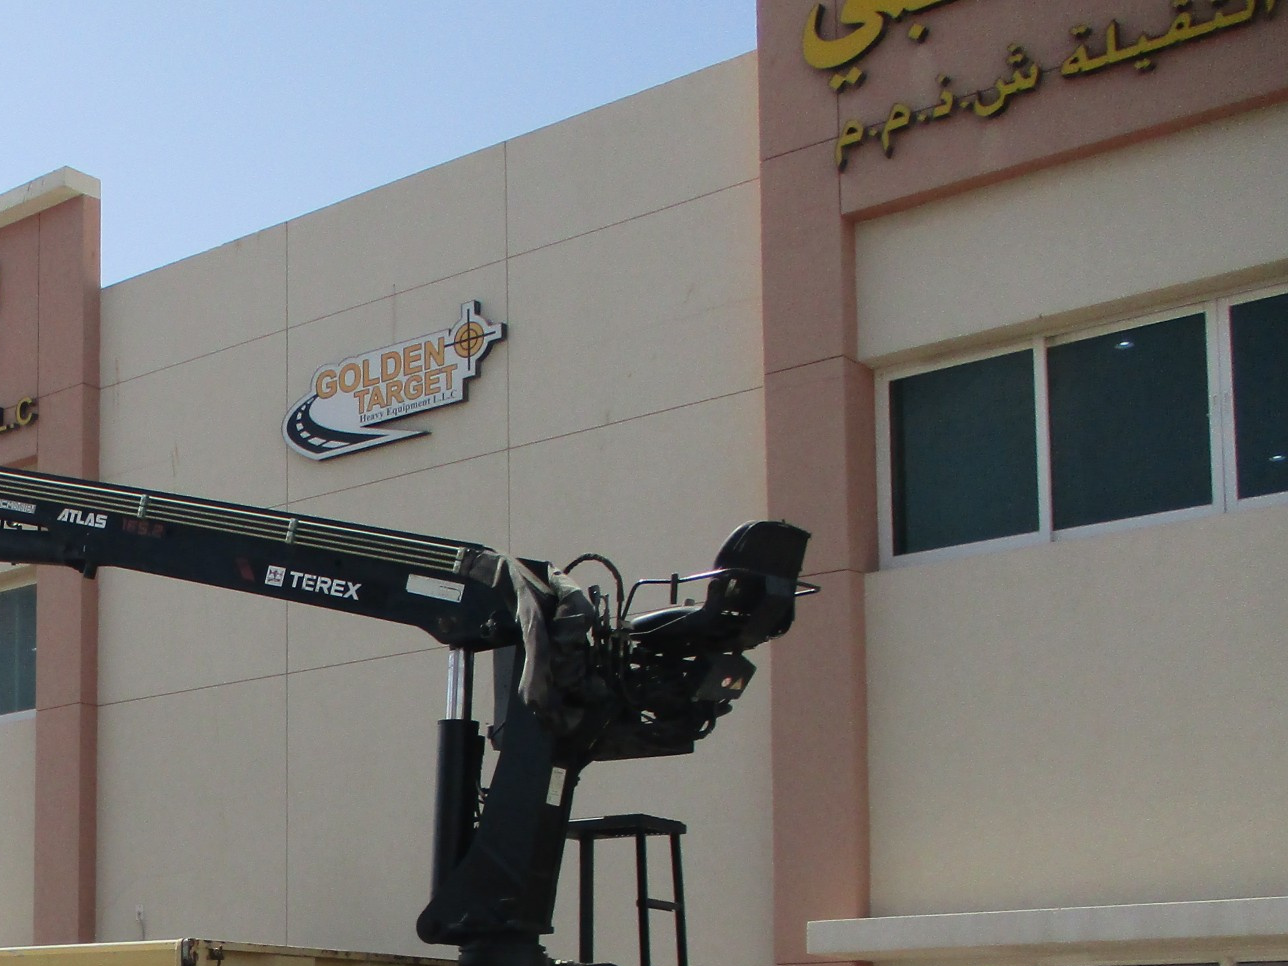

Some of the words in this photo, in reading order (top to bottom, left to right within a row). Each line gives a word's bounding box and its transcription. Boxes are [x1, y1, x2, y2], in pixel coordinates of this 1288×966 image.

[315, 337, 445, 399] GOLDEN
[354, 364, 458, 414] TARGET
[360, 411, 383, 423] Heavy
[386, 399, 431, 416] Equipment
[57, 508, 108, 529] ATLAS
[289, 571, 362, 601] TEREX
